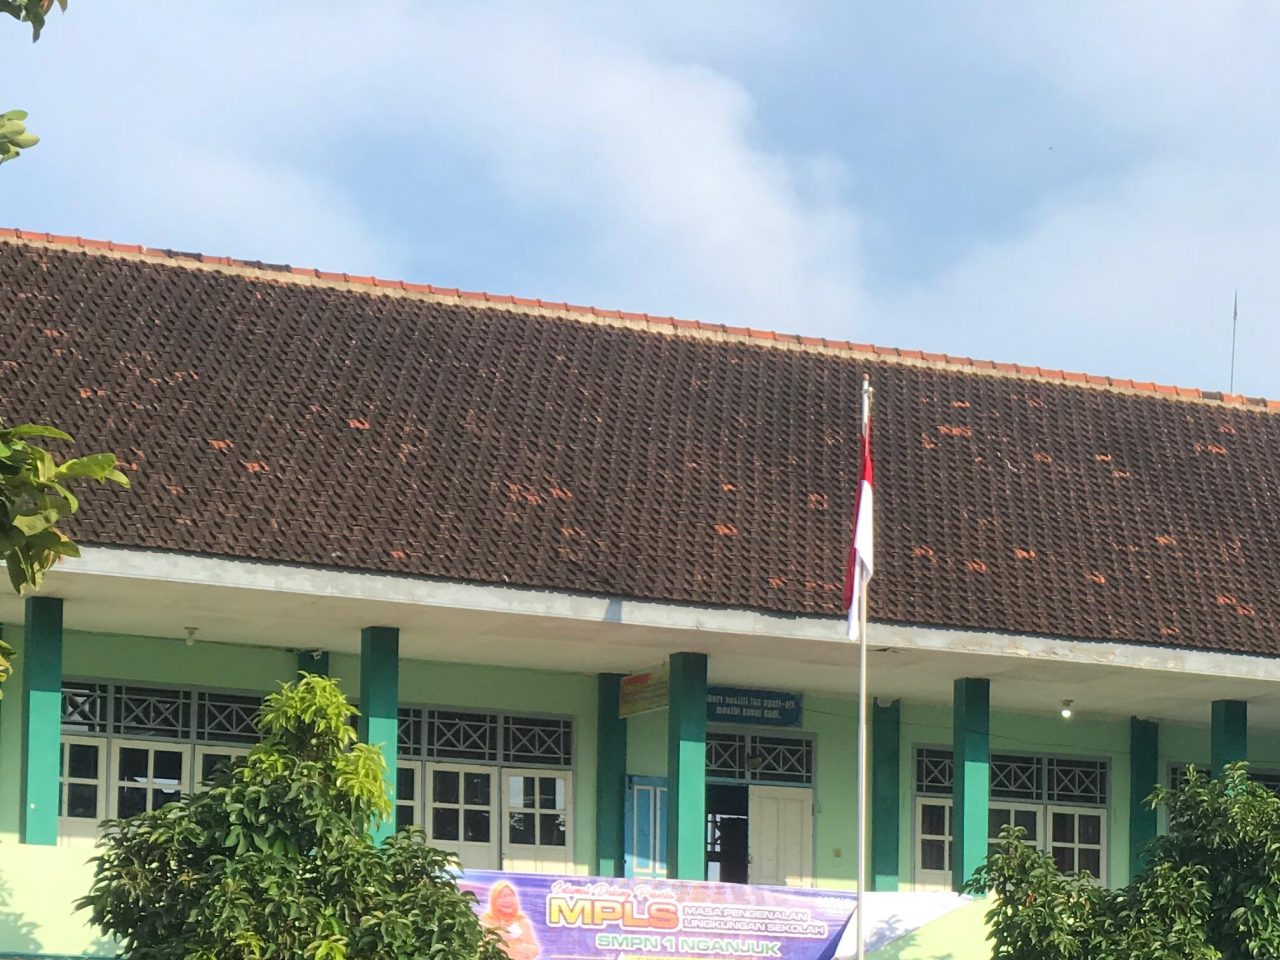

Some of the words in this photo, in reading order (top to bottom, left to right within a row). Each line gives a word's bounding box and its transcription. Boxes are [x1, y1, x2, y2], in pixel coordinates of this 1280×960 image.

[549, 897, 680, 929] MPLS
[683, 905, 722, 917] MASA
[723, 907, 809, 922] PENGENALAN
[683, 917, 766, 931] LINGKUNGAN
[766, 921, 825, 936] SEKOLAH
[597, 935, 658, 950] SMPN
[664, 937, 674, 951] 1
[680, 938, 779, 956] NGANJUK
